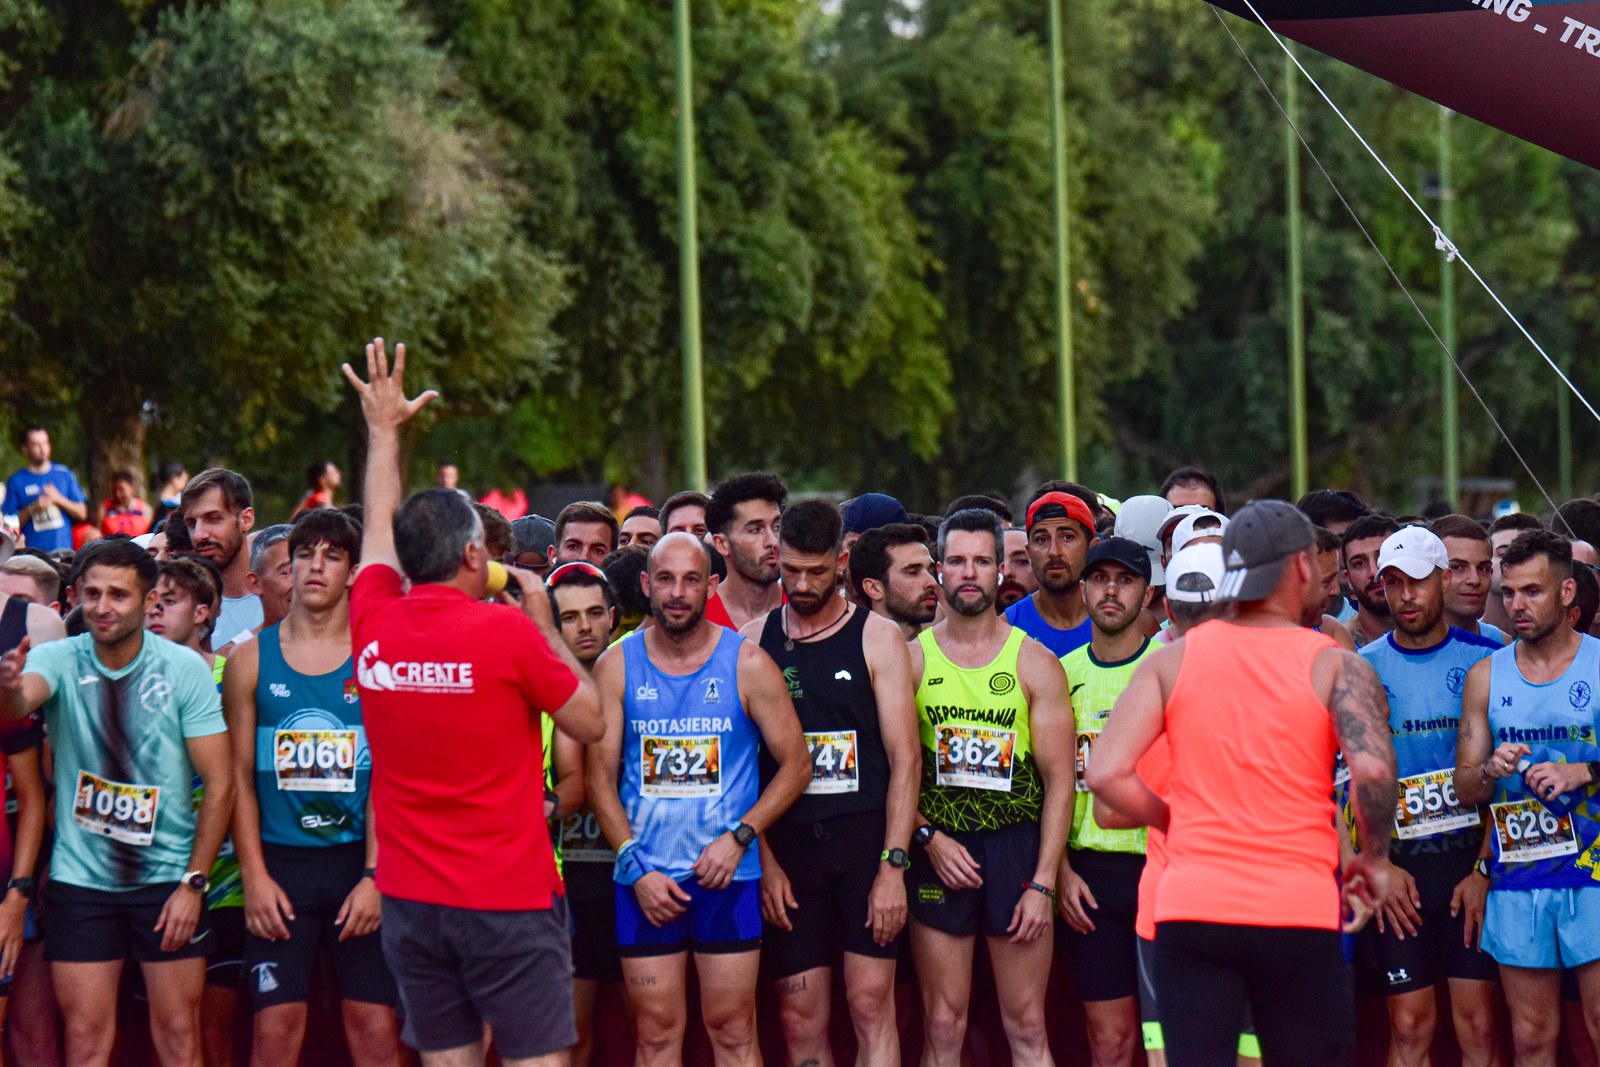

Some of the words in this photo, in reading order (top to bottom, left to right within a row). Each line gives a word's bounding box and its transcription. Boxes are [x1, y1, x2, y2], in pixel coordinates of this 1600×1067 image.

[631, 717, 733, 735] TROTASIERRA
[925, 705, 1017, 729] DEPORTEMANIA
[278, 740, 353, 770] 2060
[652, 748, 708, 777] 732
[807, 743, 853, 771] 47
[947, 736, 1000, 768] 362
[81, 783, 153, 824] 1098
[1405, 780, 1460, 815] 556
[1505, 809, 1559, 840] 626
